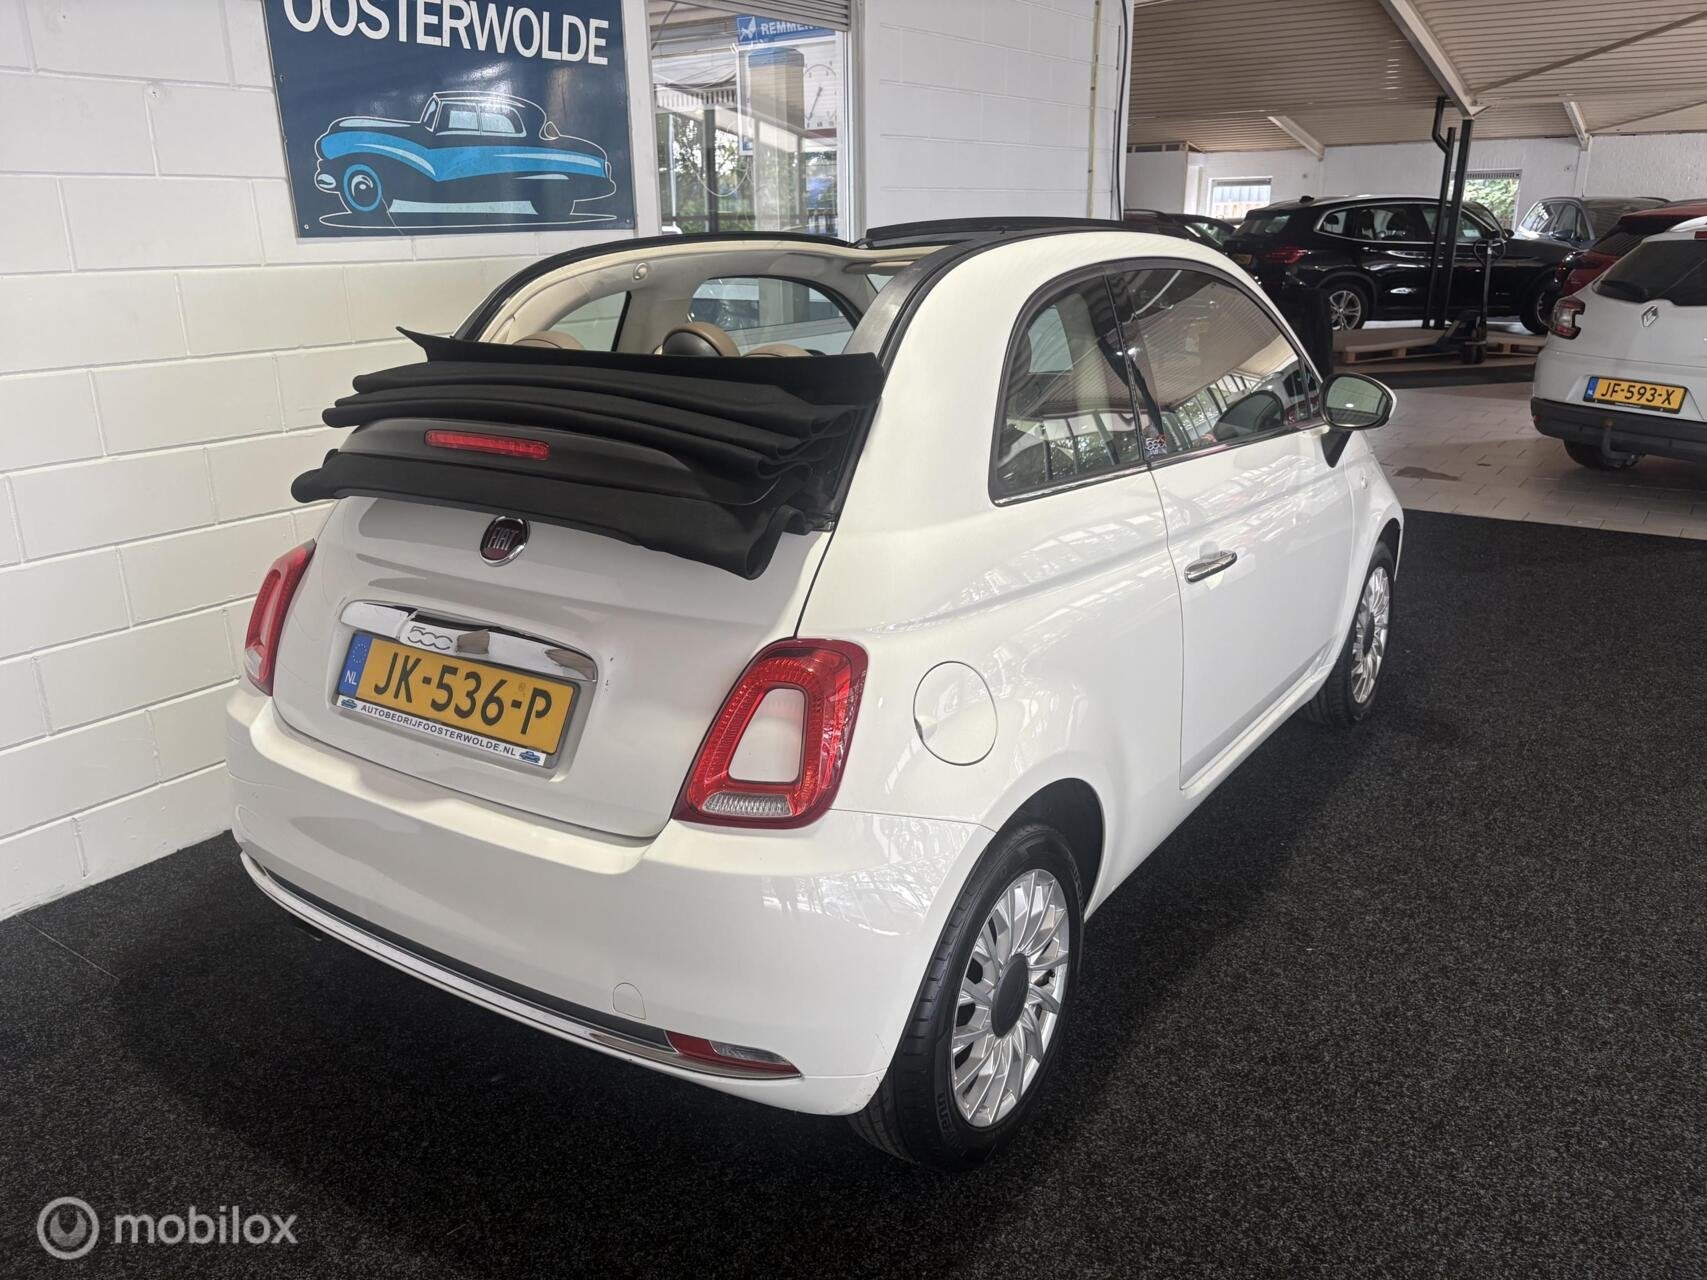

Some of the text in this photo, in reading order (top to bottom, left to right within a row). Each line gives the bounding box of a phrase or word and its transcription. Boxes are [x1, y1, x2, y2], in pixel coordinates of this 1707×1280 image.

[284, 0, 609, 65] OOSTERWOLDE
[1601, 382, 1675, 405] JF-593-X
[487, 527, 520, 551] FIAT
[408, 626, 453, 650] 500
[344, 669, 358, 686] NL
[373, 652, 552, 735] JK-536-P
[360, 704, 516, 757] AUTOBEDRIJFOOSTERWOLDE.NL
